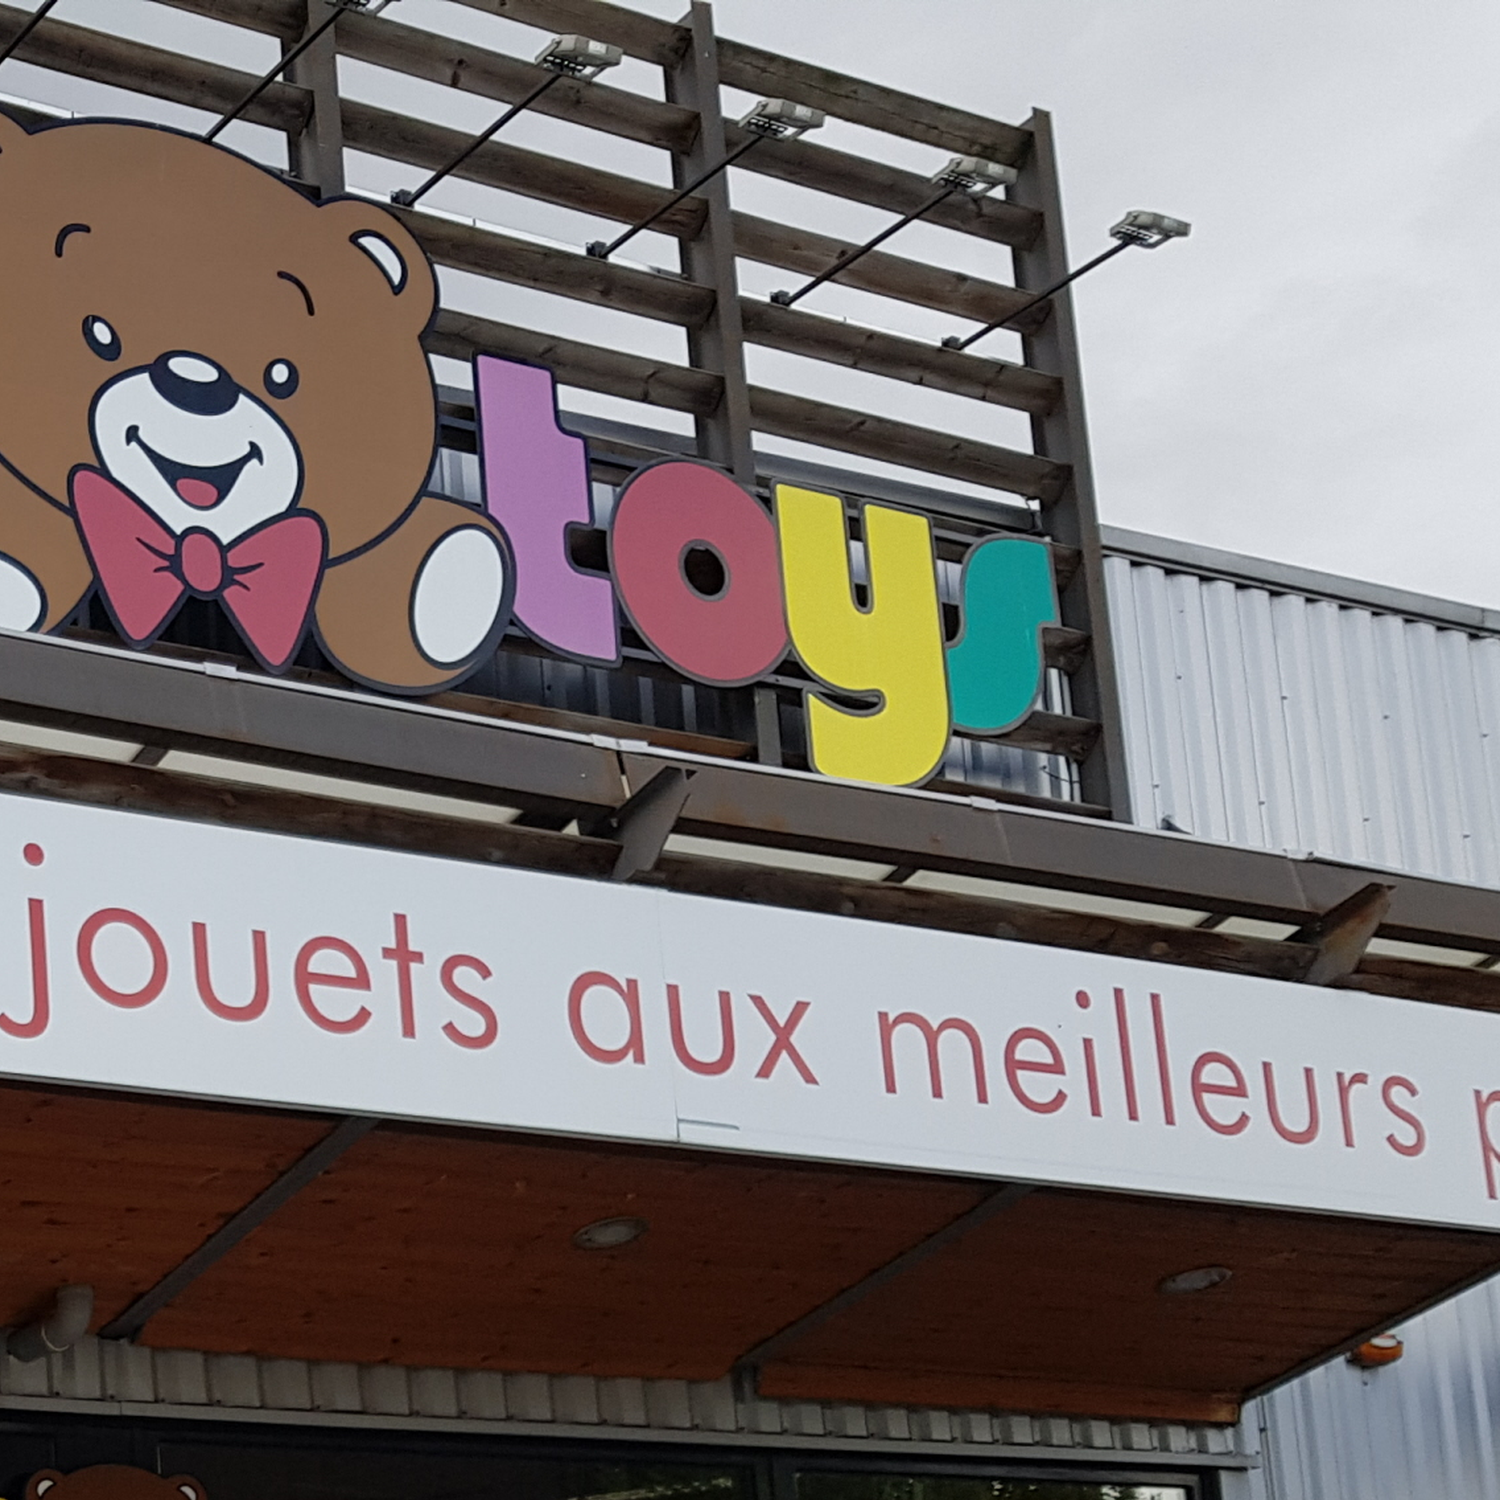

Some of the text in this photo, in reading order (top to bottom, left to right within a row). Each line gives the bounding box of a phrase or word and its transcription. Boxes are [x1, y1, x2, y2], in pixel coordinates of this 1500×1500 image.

[473, 352, 1057, 788] toys
[567, 970, 819, 1087] aux
[877, 986, 1426, 1157] meilleurs
